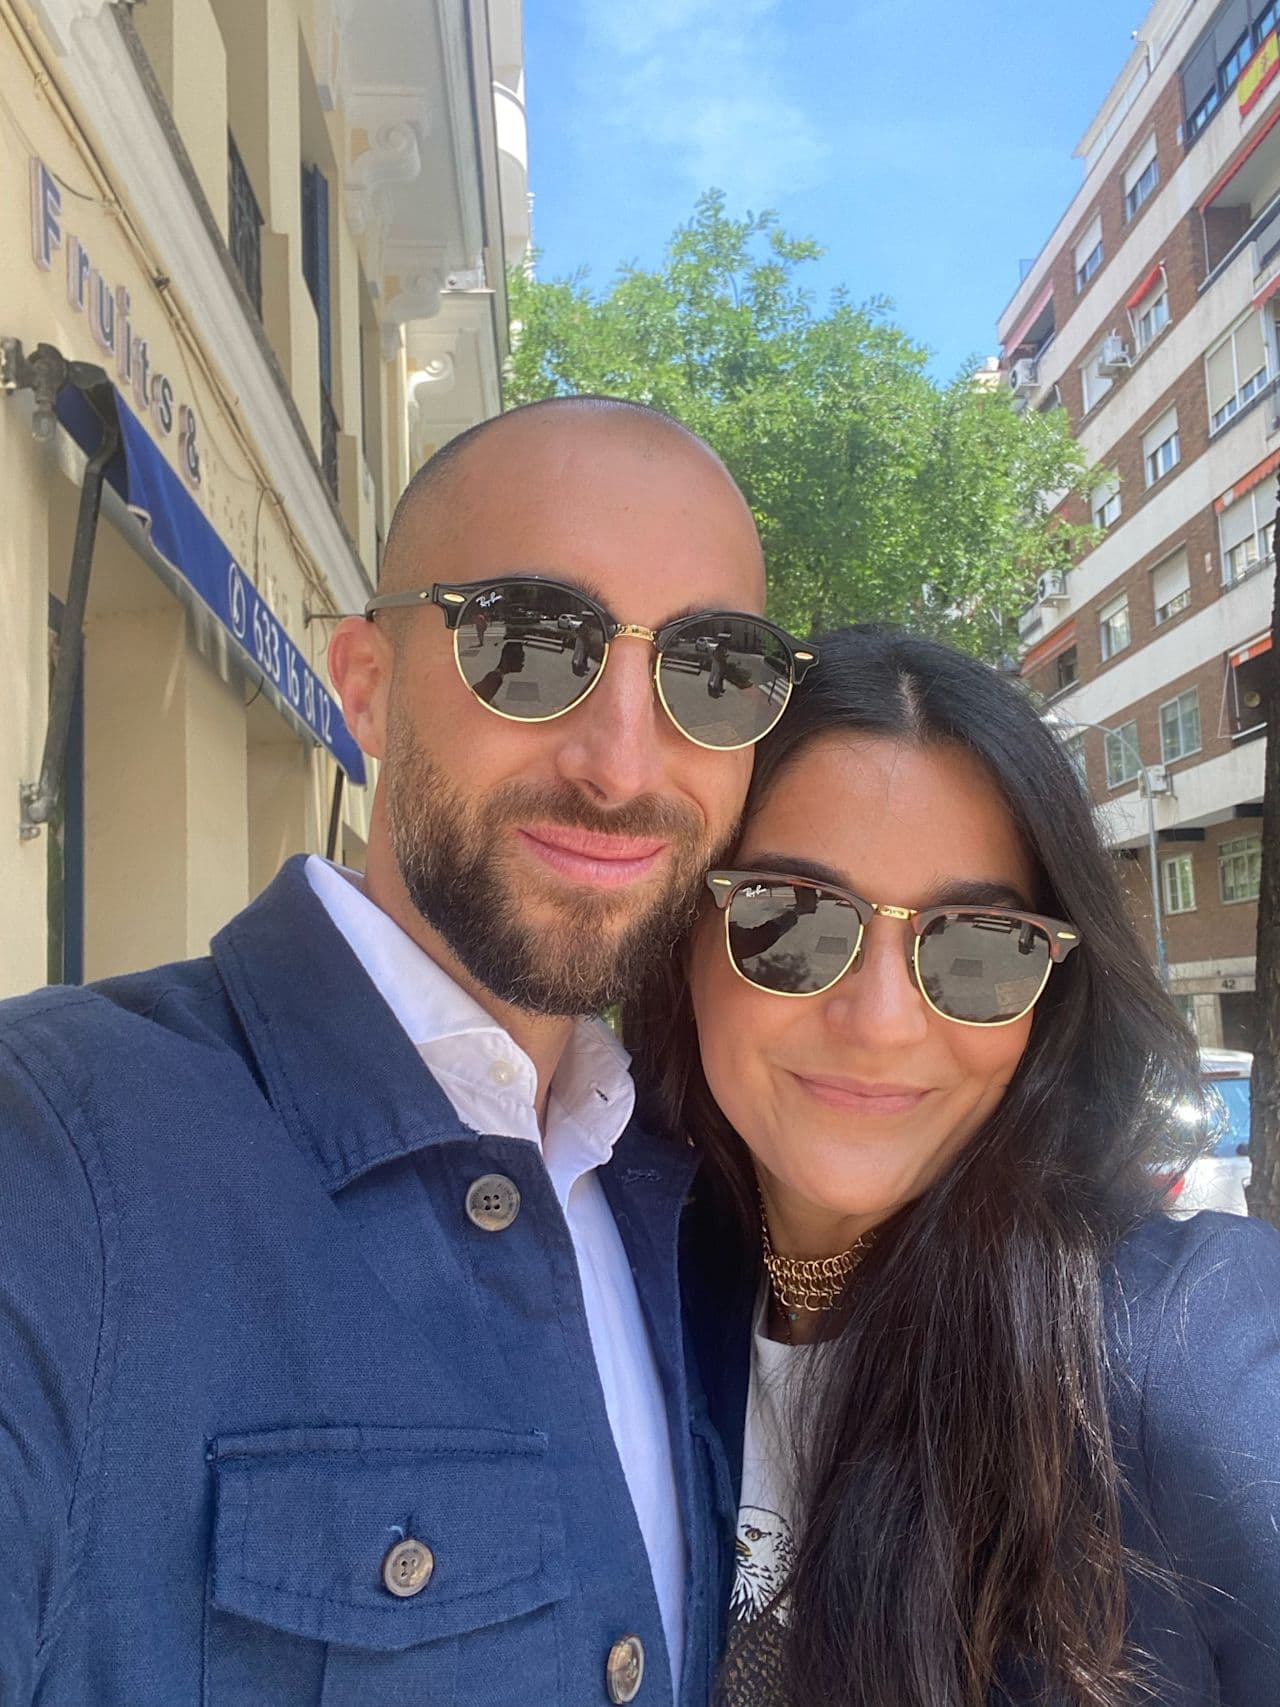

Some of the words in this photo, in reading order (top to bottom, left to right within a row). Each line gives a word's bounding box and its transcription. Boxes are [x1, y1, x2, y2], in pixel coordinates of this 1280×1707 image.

[30, 155, 173, 435] Fruits
[253, 598, 280, 683] 633
[284, 641, 300, 706] 16
[304, 667, 316, 727] 81
[319, 687, 333, 744] 12
